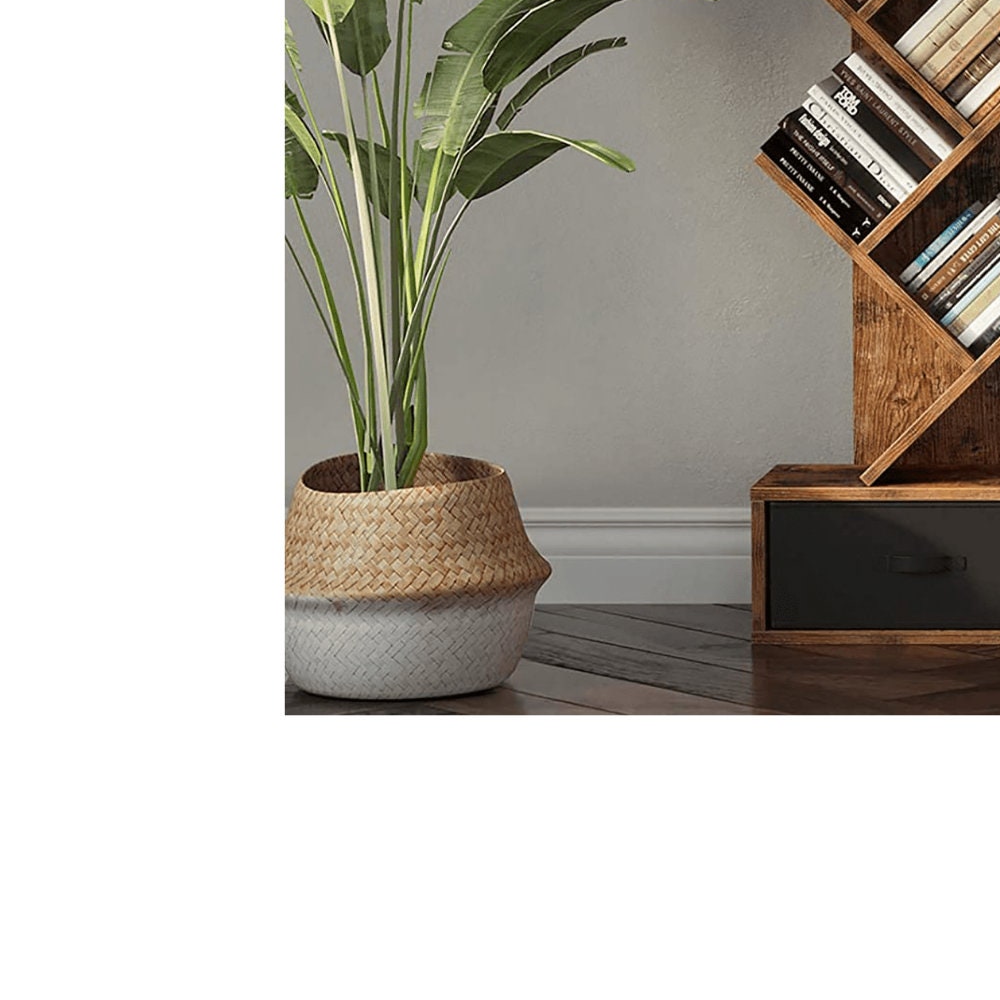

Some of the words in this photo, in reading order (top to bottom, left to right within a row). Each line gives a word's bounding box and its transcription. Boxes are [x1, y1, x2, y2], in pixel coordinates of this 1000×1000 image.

[833, 91, 859, 117] FORD
[838, 85, 861, 108] TOM
[839, 69, 857, 86] YVES
[855, 84, 874, 103] SAINT
[872, 101, 899, 128] LAURENT
[897, 126, 918, 146] STYLE
[788, 146, 809, 166] PRETTY
[806, 99, 867, 160] Christian
[866, 159, 900, 193] Dior
[778, 157, 799, 176] PRETTY
